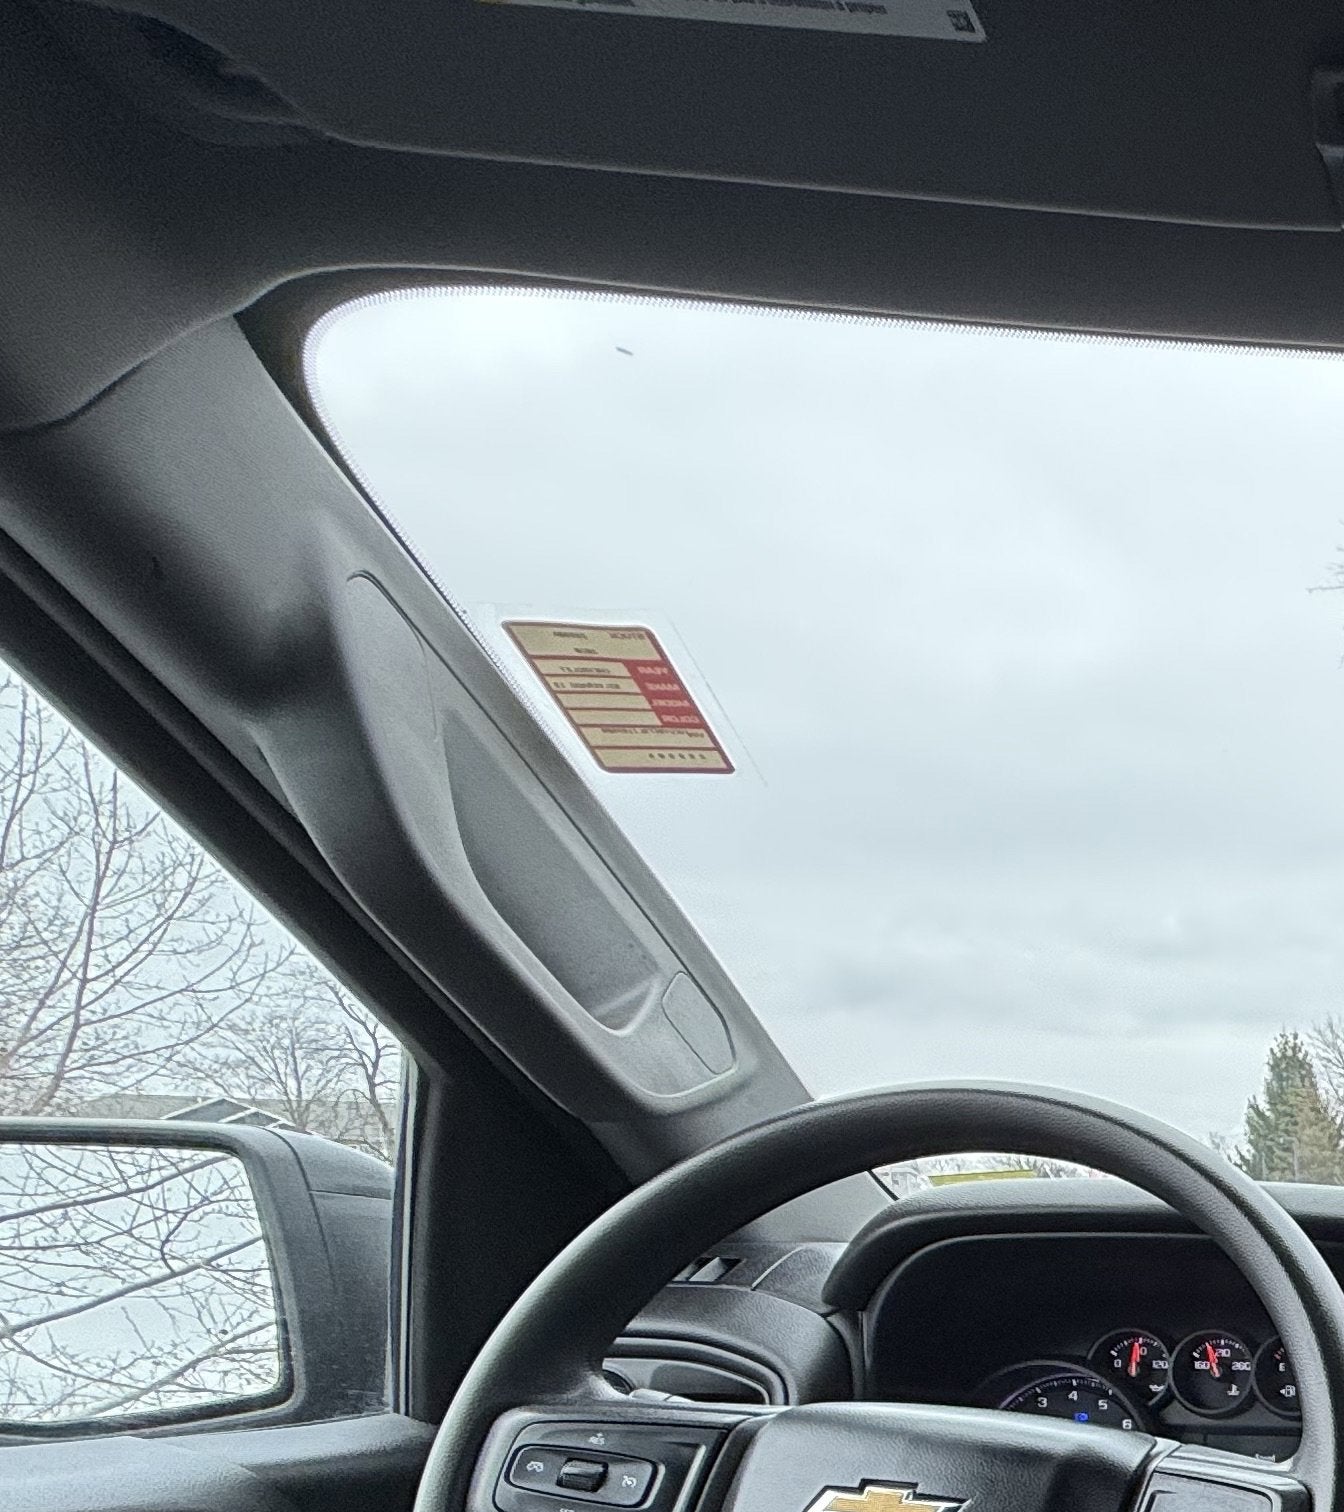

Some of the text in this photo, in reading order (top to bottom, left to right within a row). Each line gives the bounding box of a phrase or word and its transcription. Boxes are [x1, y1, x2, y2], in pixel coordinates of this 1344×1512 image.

[1067, 1390, 1078, 1401] 4
[1037, 1397, 1048, 1408] 3
[1098, 1399, 1108, 1410] 5
[1122, 1419, 1133, 1430] 6
